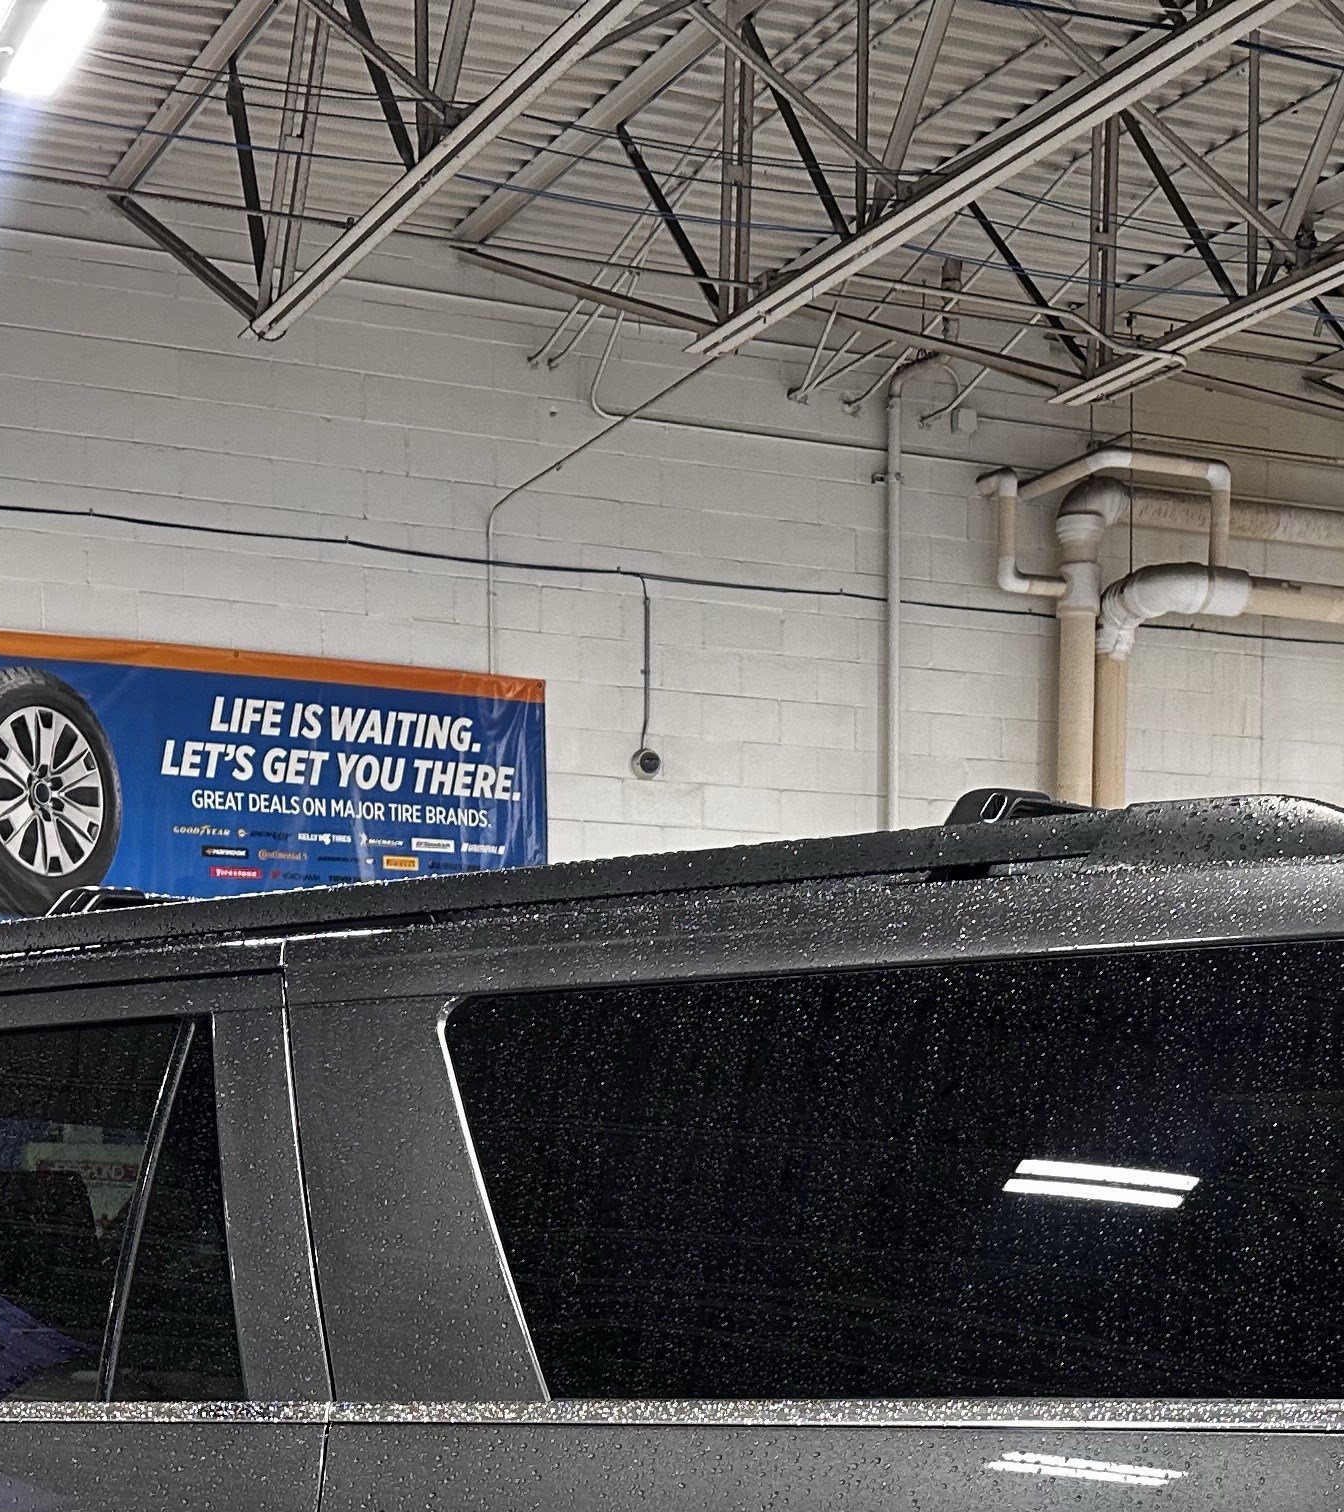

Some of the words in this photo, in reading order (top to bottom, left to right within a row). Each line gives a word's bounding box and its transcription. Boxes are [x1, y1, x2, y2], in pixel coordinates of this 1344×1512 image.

[210, 696, 286, 737] LIFE
[289, 702, 322, 740] IS
[329, 706, 481, 753] WAITING.
[160, 739, 255, 781] LET'S
[262, 747, 330, 786] GET
[336, 753, 406, 793] YOU
[412, 759, 521, 801] THERE.
[173, 824, 231, 837] GOODYEAR
[191, 789, 243, 813] GREAT
[248, 791, 299, 816] DEALS
[303, 796, 327, 817] ON
[330, 799, 385, 822] MAJOR
[388, 803, 422, 824] TIRE
[425, 806, 492, 829] BRANDS.
